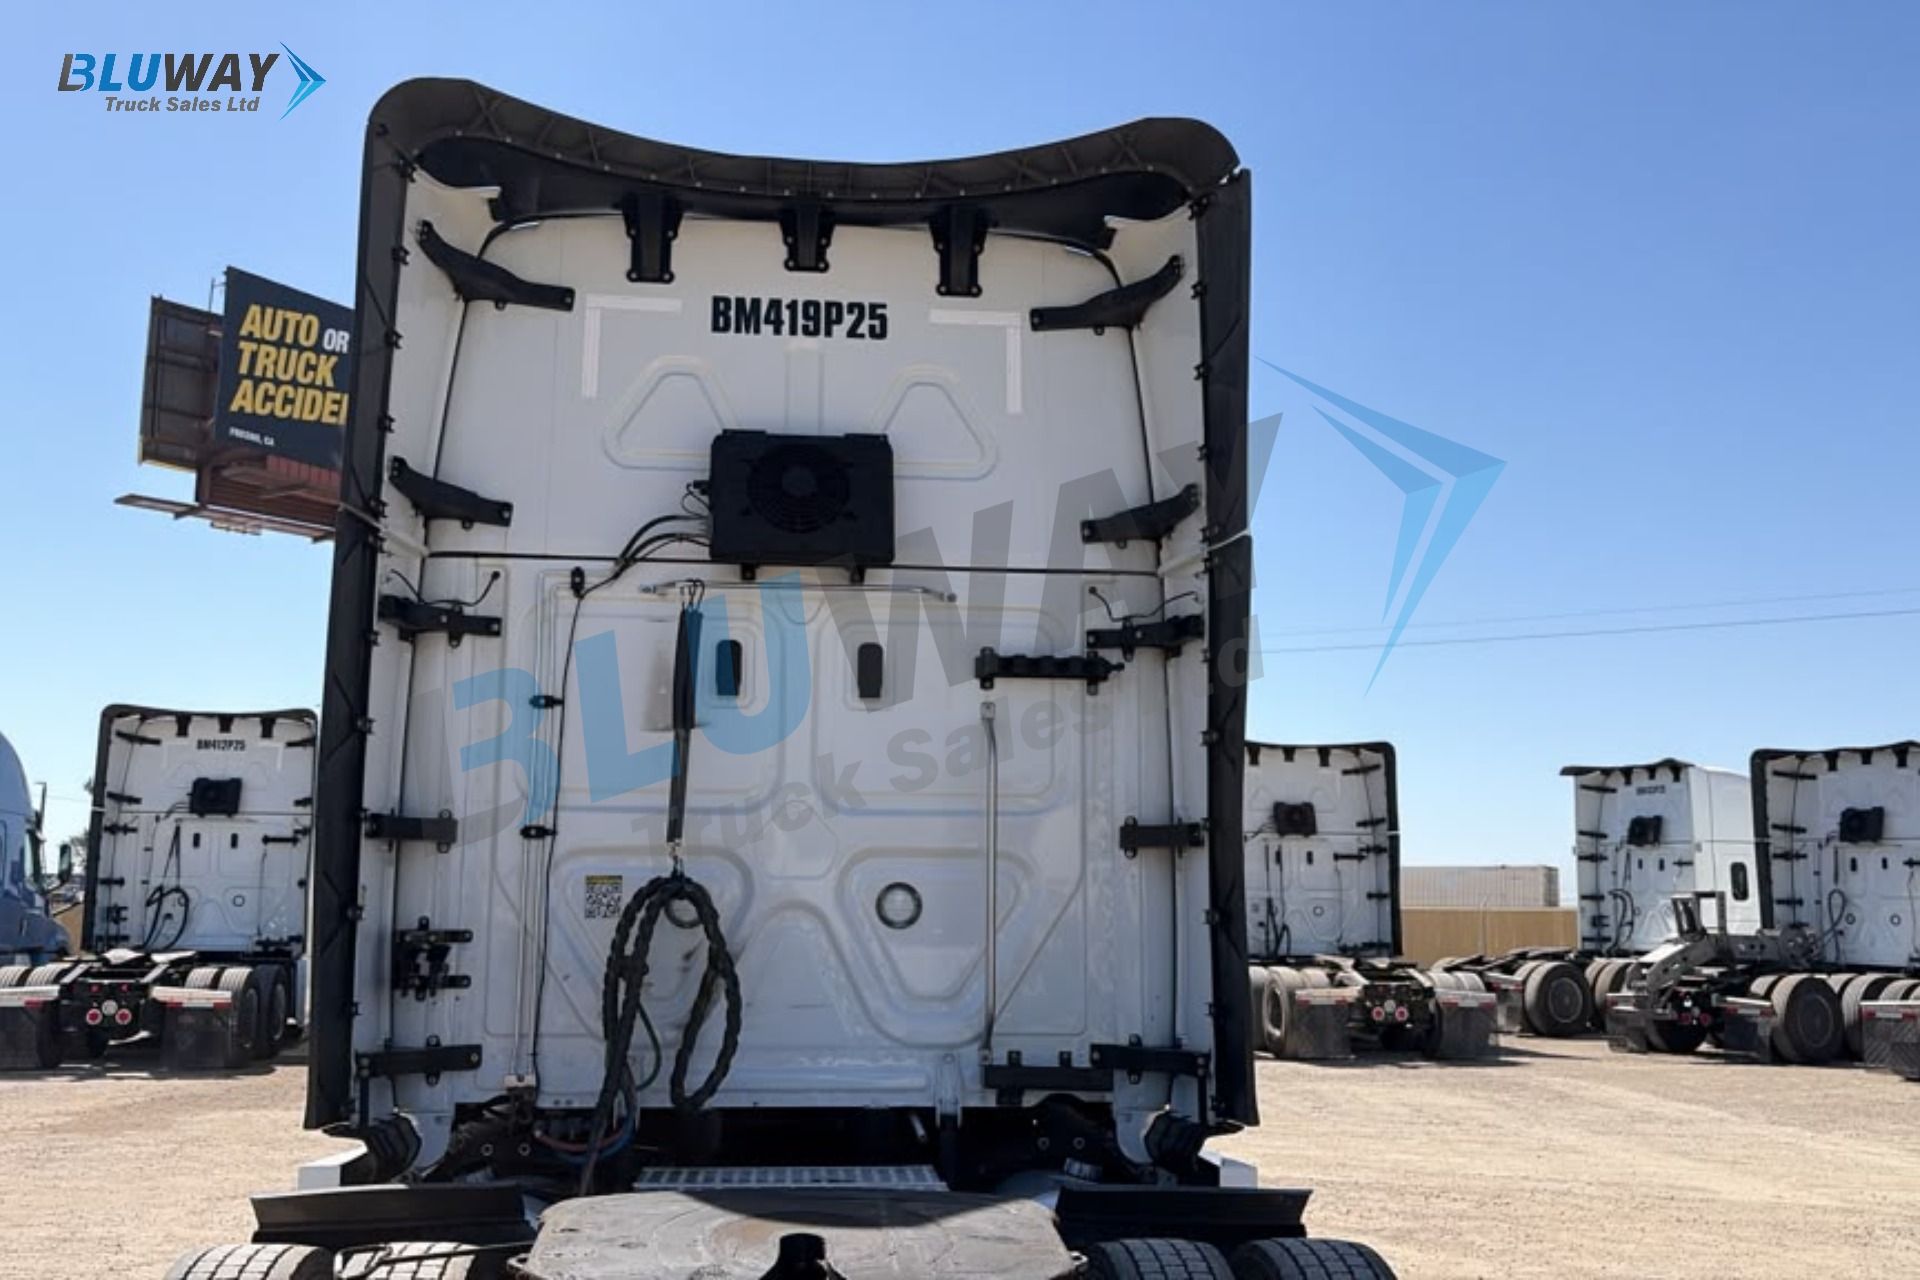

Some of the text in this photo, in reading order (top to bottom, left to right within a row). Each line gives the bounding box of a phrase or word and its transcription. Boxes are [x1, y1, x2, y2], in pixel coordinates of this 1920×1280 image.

[239, 303, 350, 354] AUTO OR
[710, 295, 888, 340] BM419P25
[237, 340, 339, 388] TRUCK
